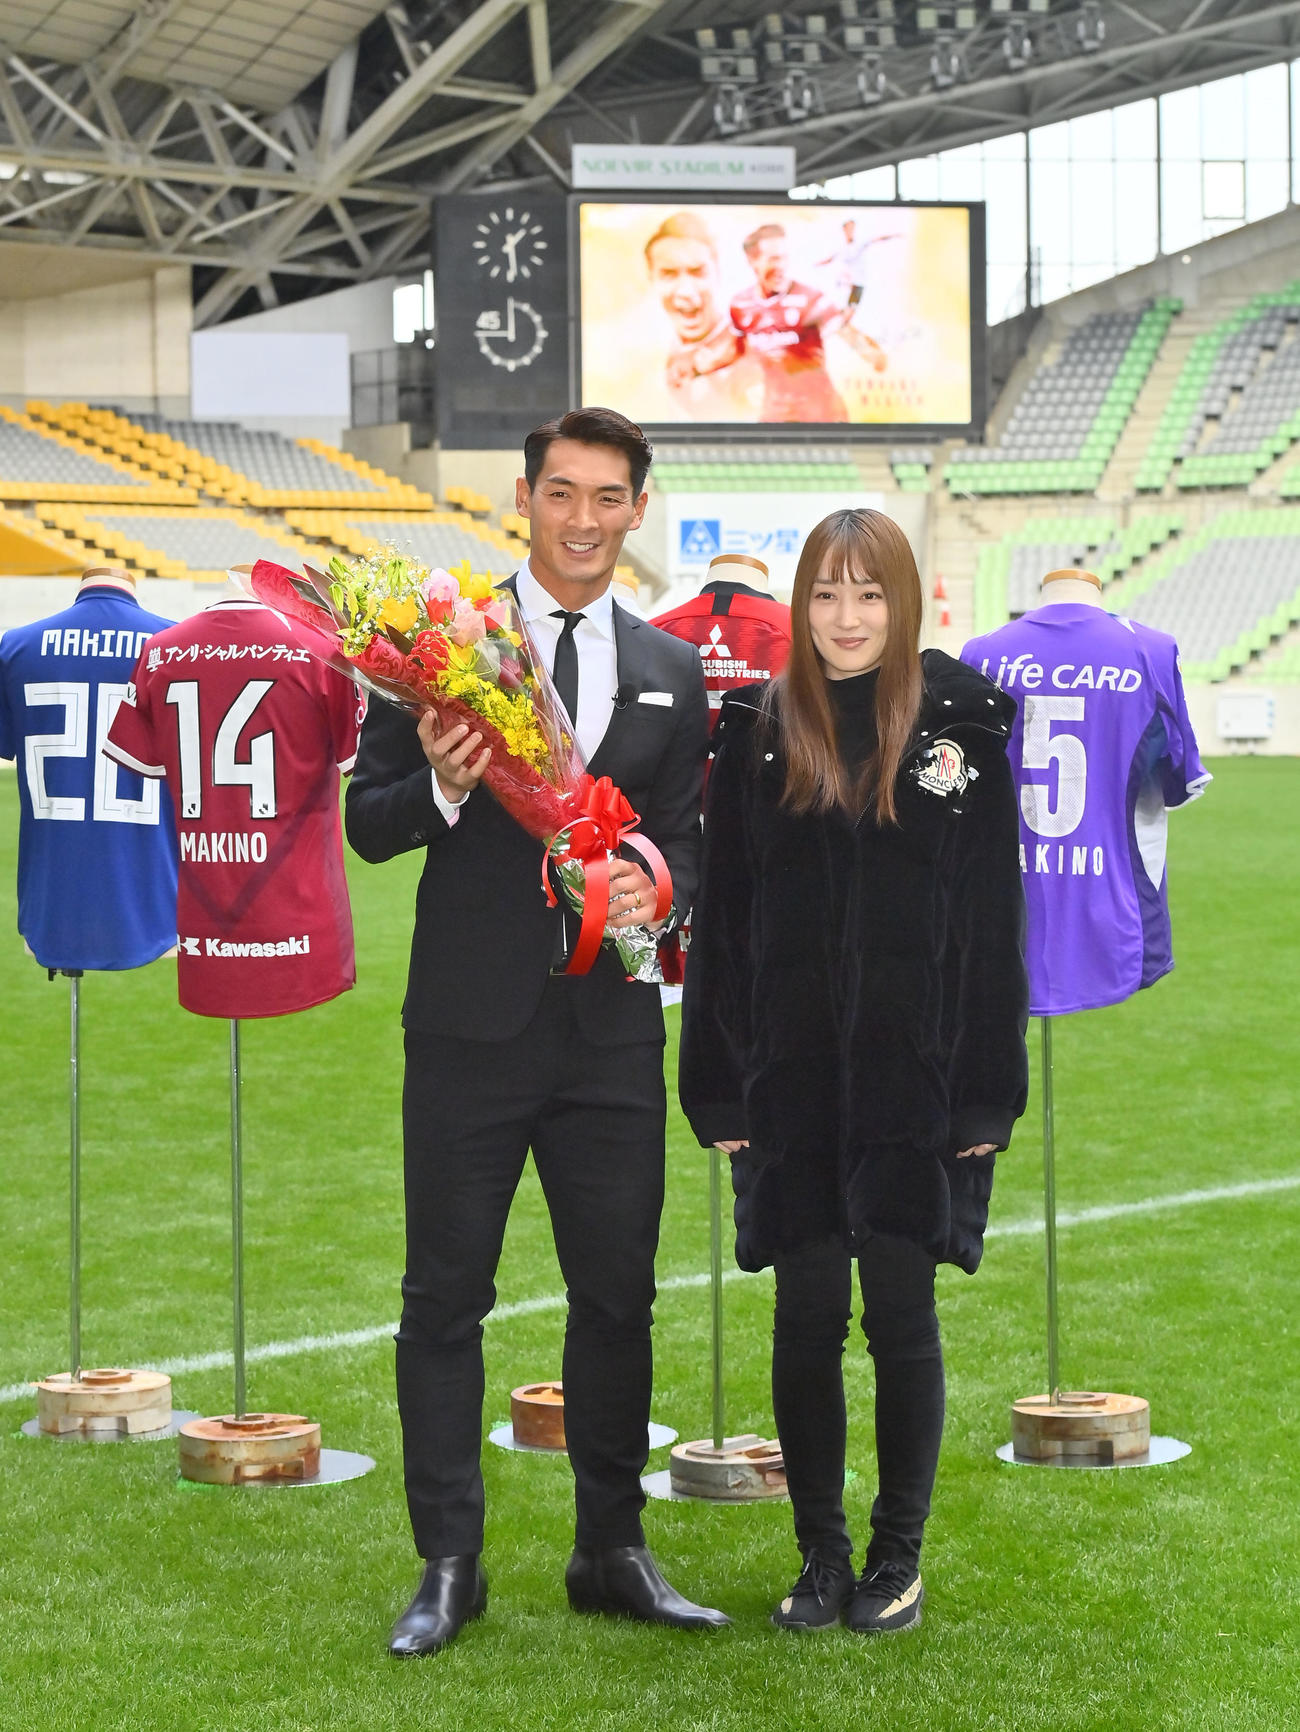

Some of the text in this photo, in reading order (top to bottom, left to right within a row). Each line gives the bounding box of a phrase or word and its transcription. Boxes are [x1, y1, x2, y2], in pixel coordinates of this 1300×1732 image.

[581, 158, 652, 174] NOEVIR
[659, 159, 744, 176] STADIUM
[476, 311, 501, 330] 45
[701, 659, 748, 669] SUBISHI
[703, 668, 771, 679] NDUSTRIES
[1052, 664, 1143, 693] CARD
[165, 679, 277, 819] 14
[1020, 695, 1087, 838] 5
[921, 771, 964, 789] MONCLER
[180, 832, 267, 863] MAKINO
[1019, 843, 1104, 876] AKINO
[205, 935, 310, 957] Kawasaki
